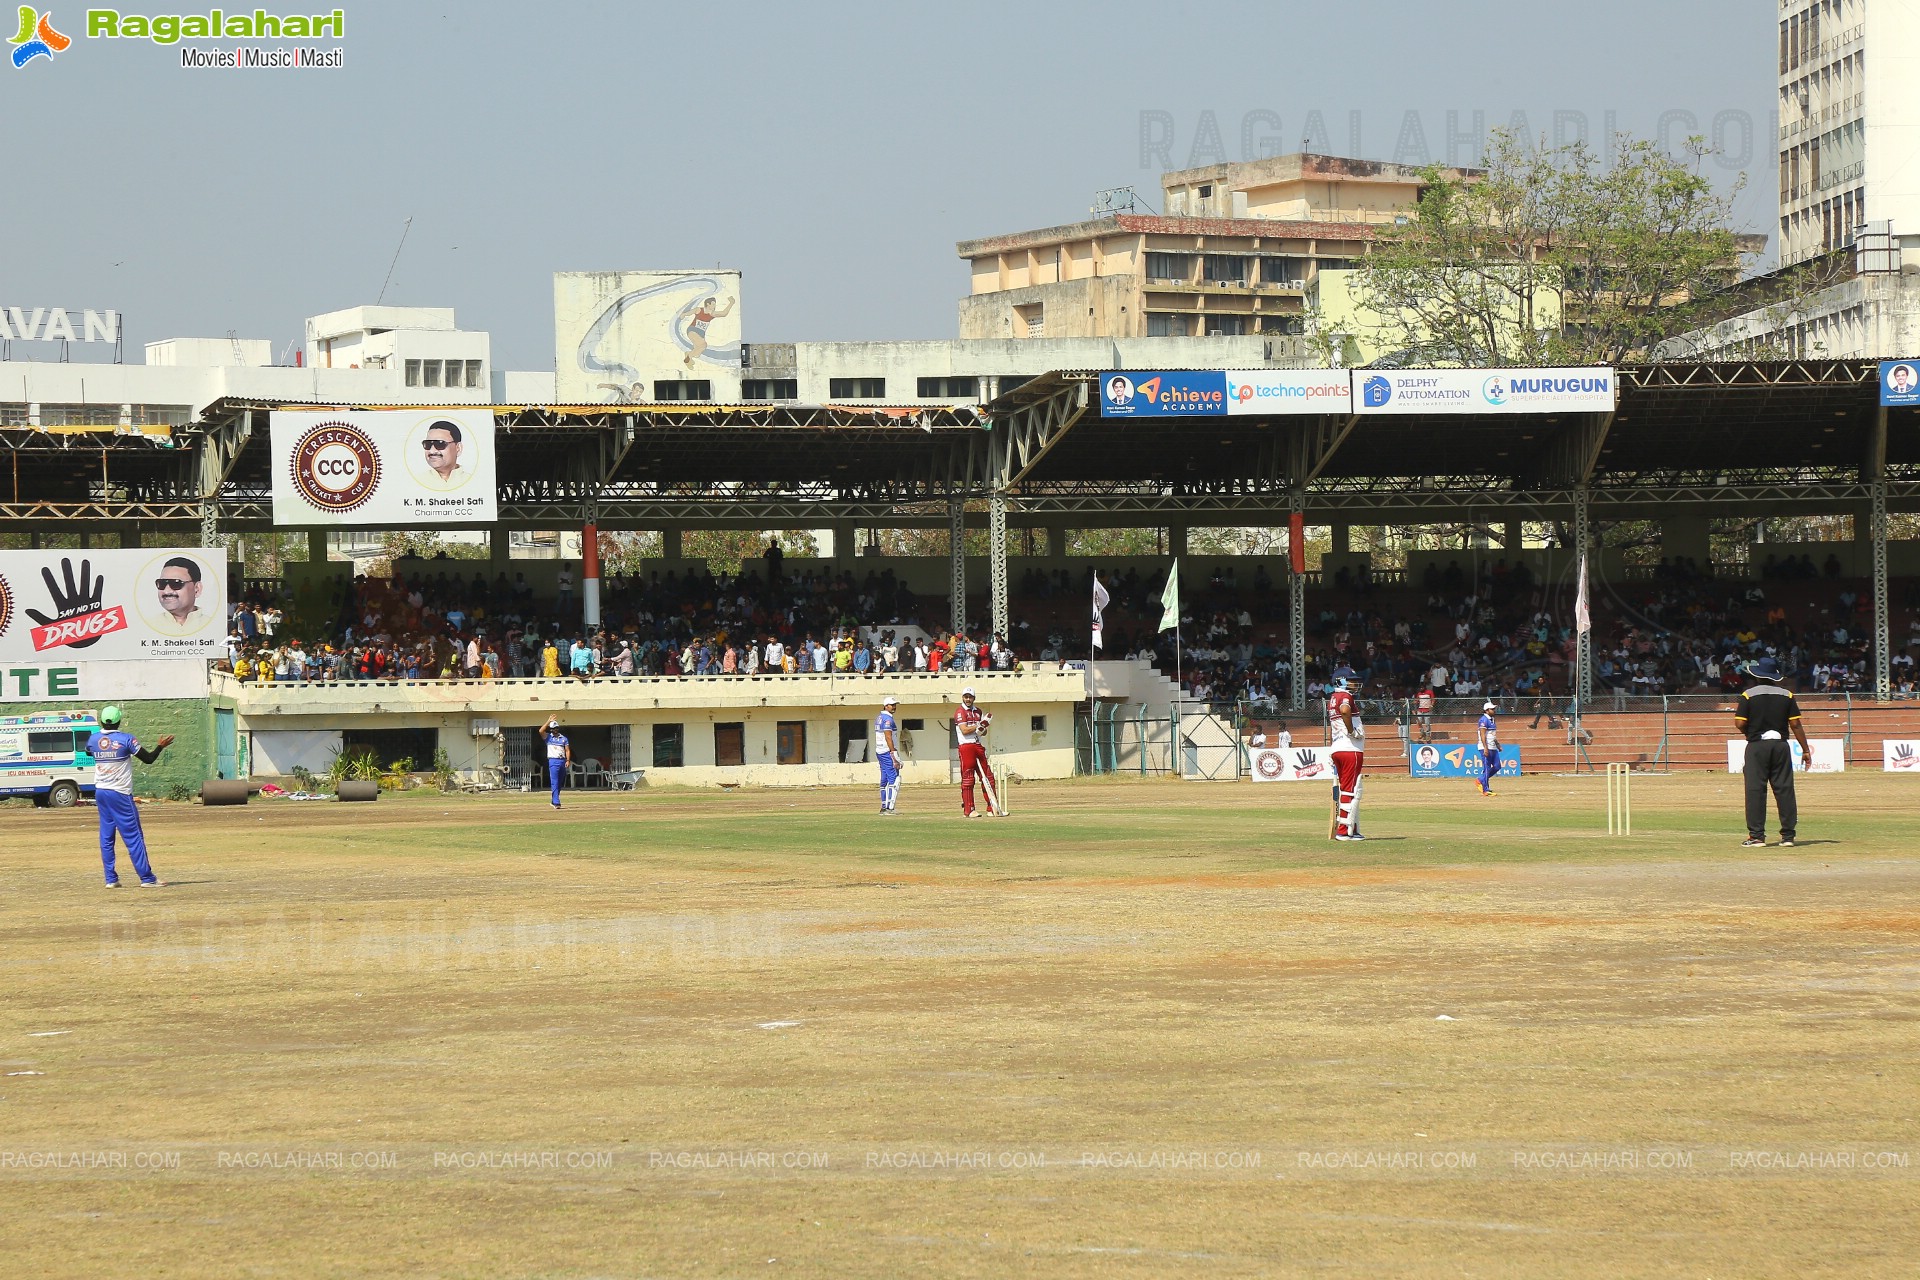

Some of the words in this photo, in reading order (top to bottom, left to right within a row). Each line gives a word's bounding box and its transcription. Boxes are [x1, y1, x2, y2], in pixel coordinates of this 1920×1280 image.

[1256, 383, 1350, 400] technopaints
[1397, 379, 1438, 388] DELPHY
[1511, 379, 1608, 393] MURUGUN
[1398, 390, 1470, 399] AUTOMATION
[1162, 404, 1222, 412] ACADEMY
[306, 432, 366, 456] CRESCENT
[318, 460, 355, 476] CCC
[308, 480, 332, 500] CRICKET
[352, 482, 364, 495] CUP
[59, 608, 75, 618] SAY
[76, 604, 88, 614] NO
[90, 602, 100, 610] TO
[42, 610, 119, 647] DRUGS
